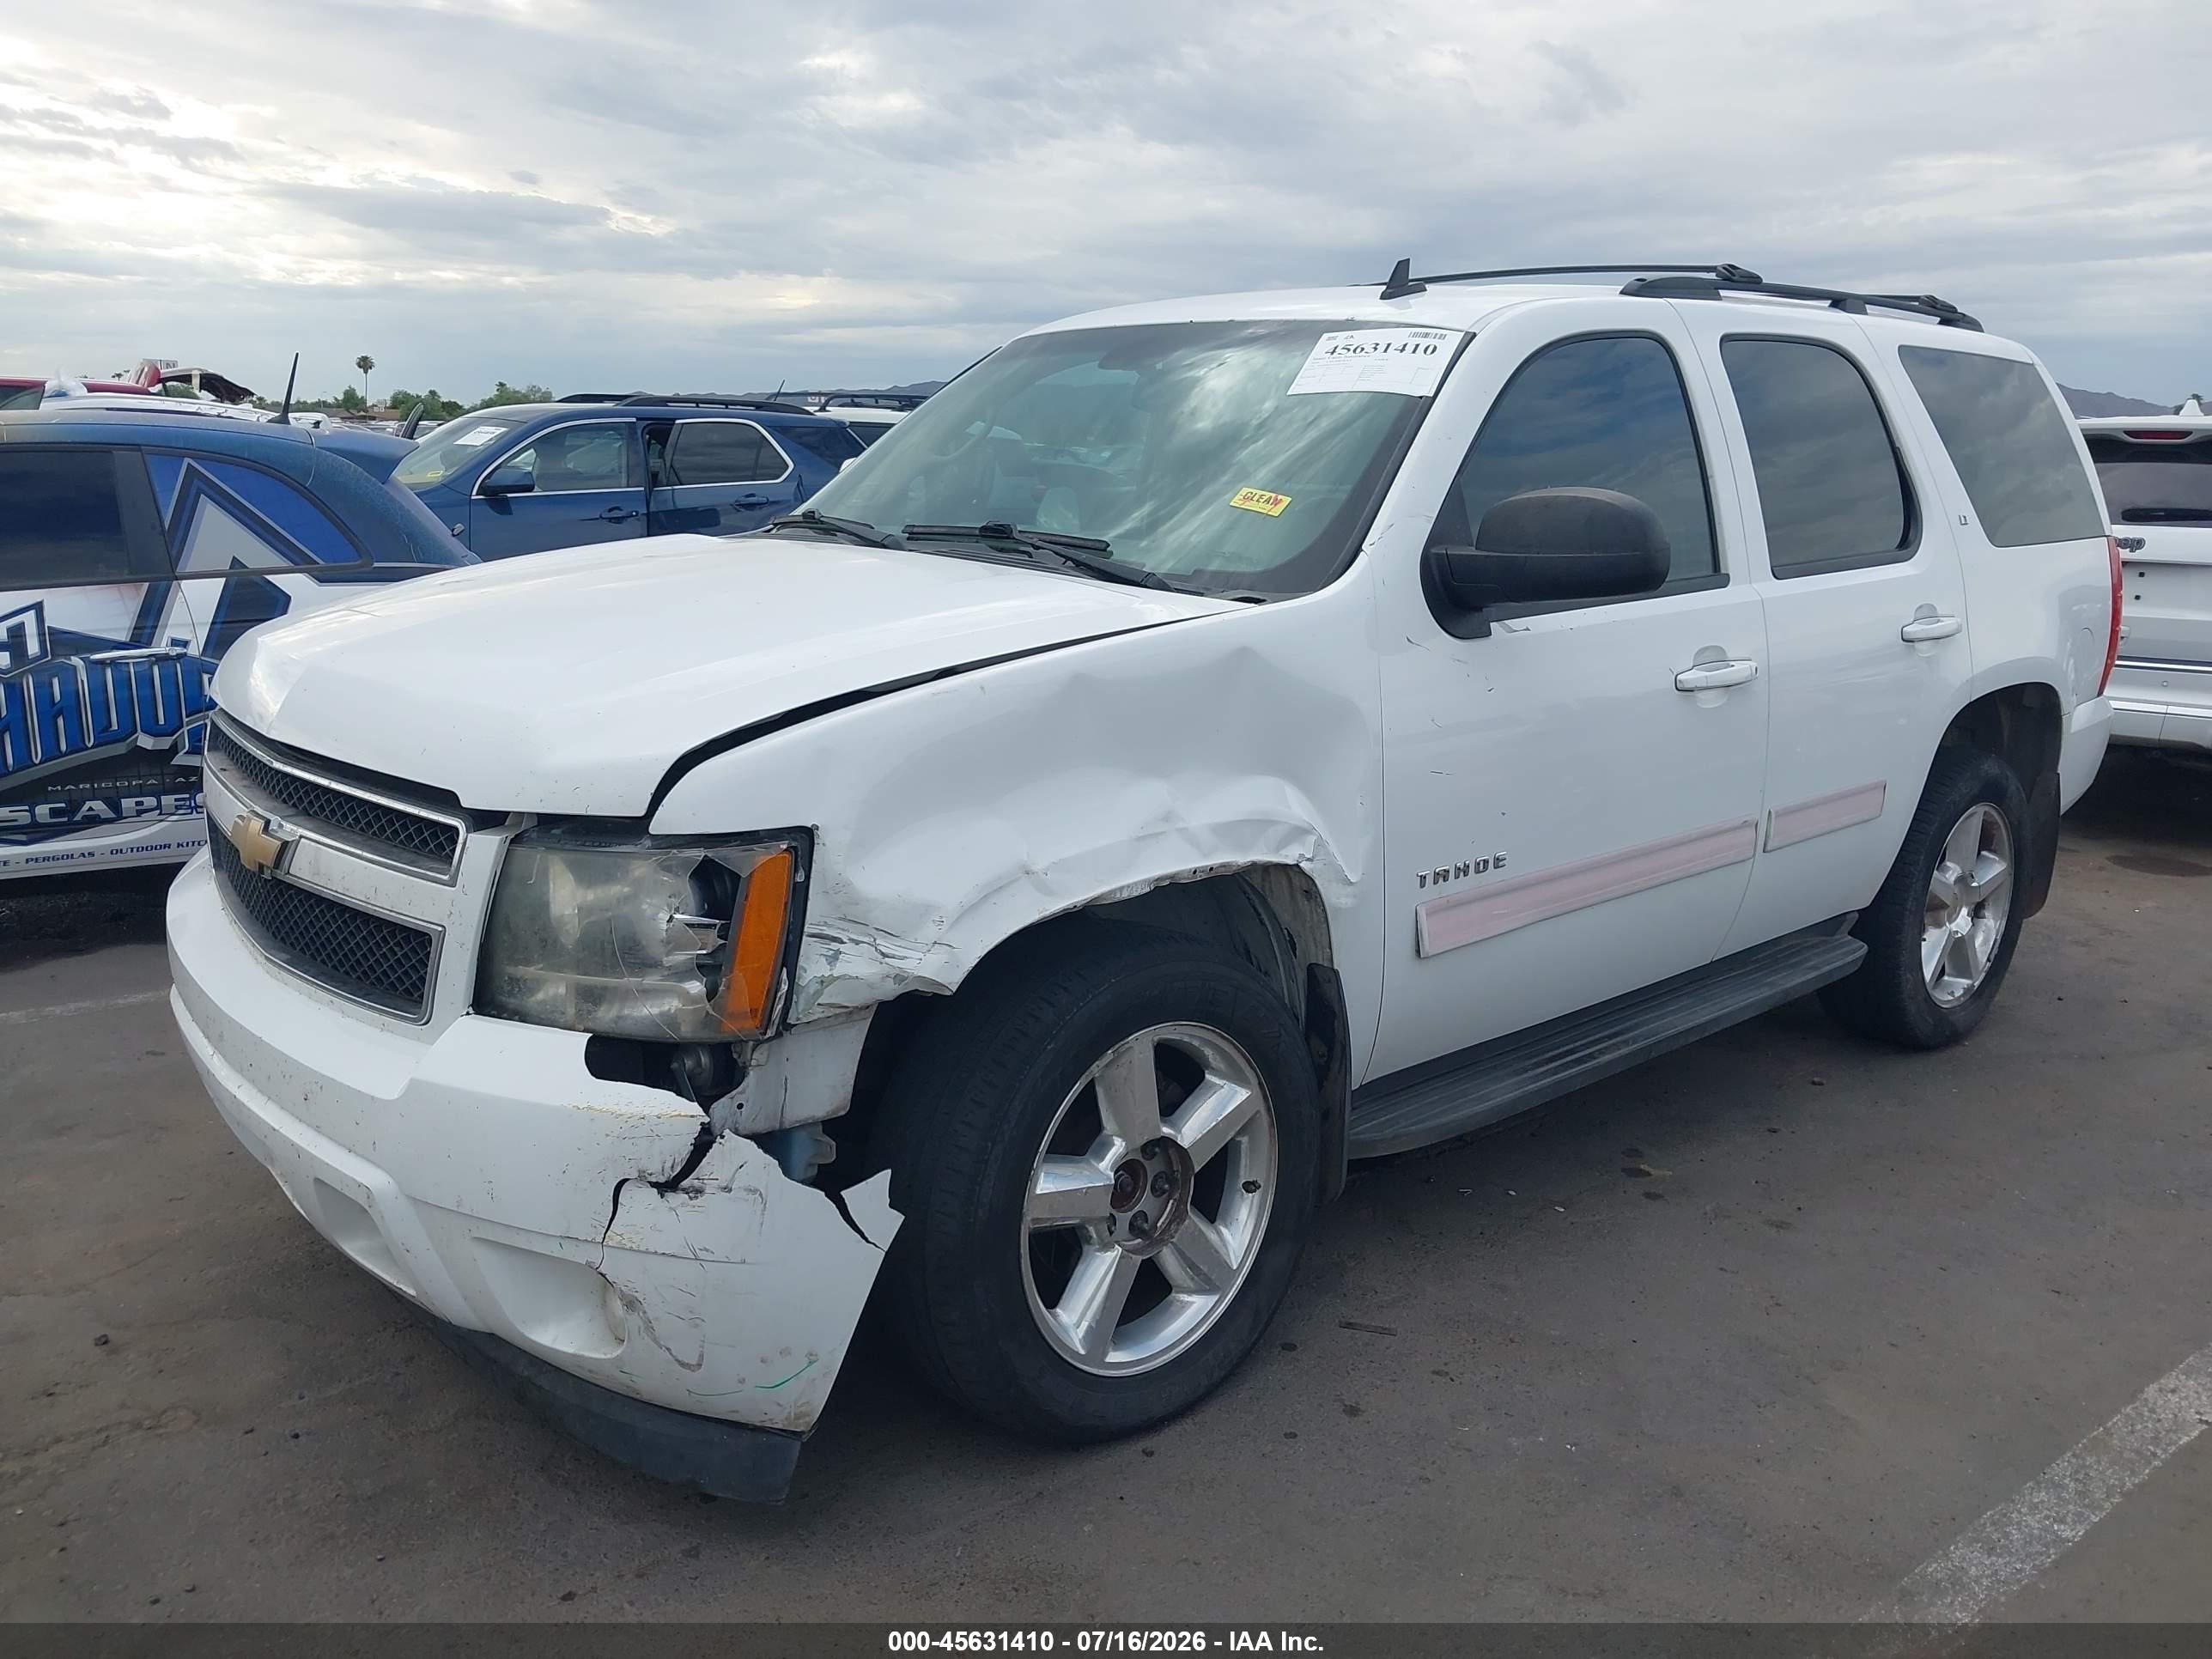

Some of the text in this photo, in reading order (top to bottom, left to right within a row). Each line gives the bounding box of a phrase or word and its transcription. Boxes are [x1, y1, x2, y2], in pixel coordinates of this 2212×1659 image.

[1325, 342, 1438, 356] 45631410
[48, 779, 159, 791] MARICOPA
[26, 851, 95, 865] PERGOLAS
[110, 843, 172, 855] OUTDOOR
[1416, 851, 1507, 888] TAHOE
